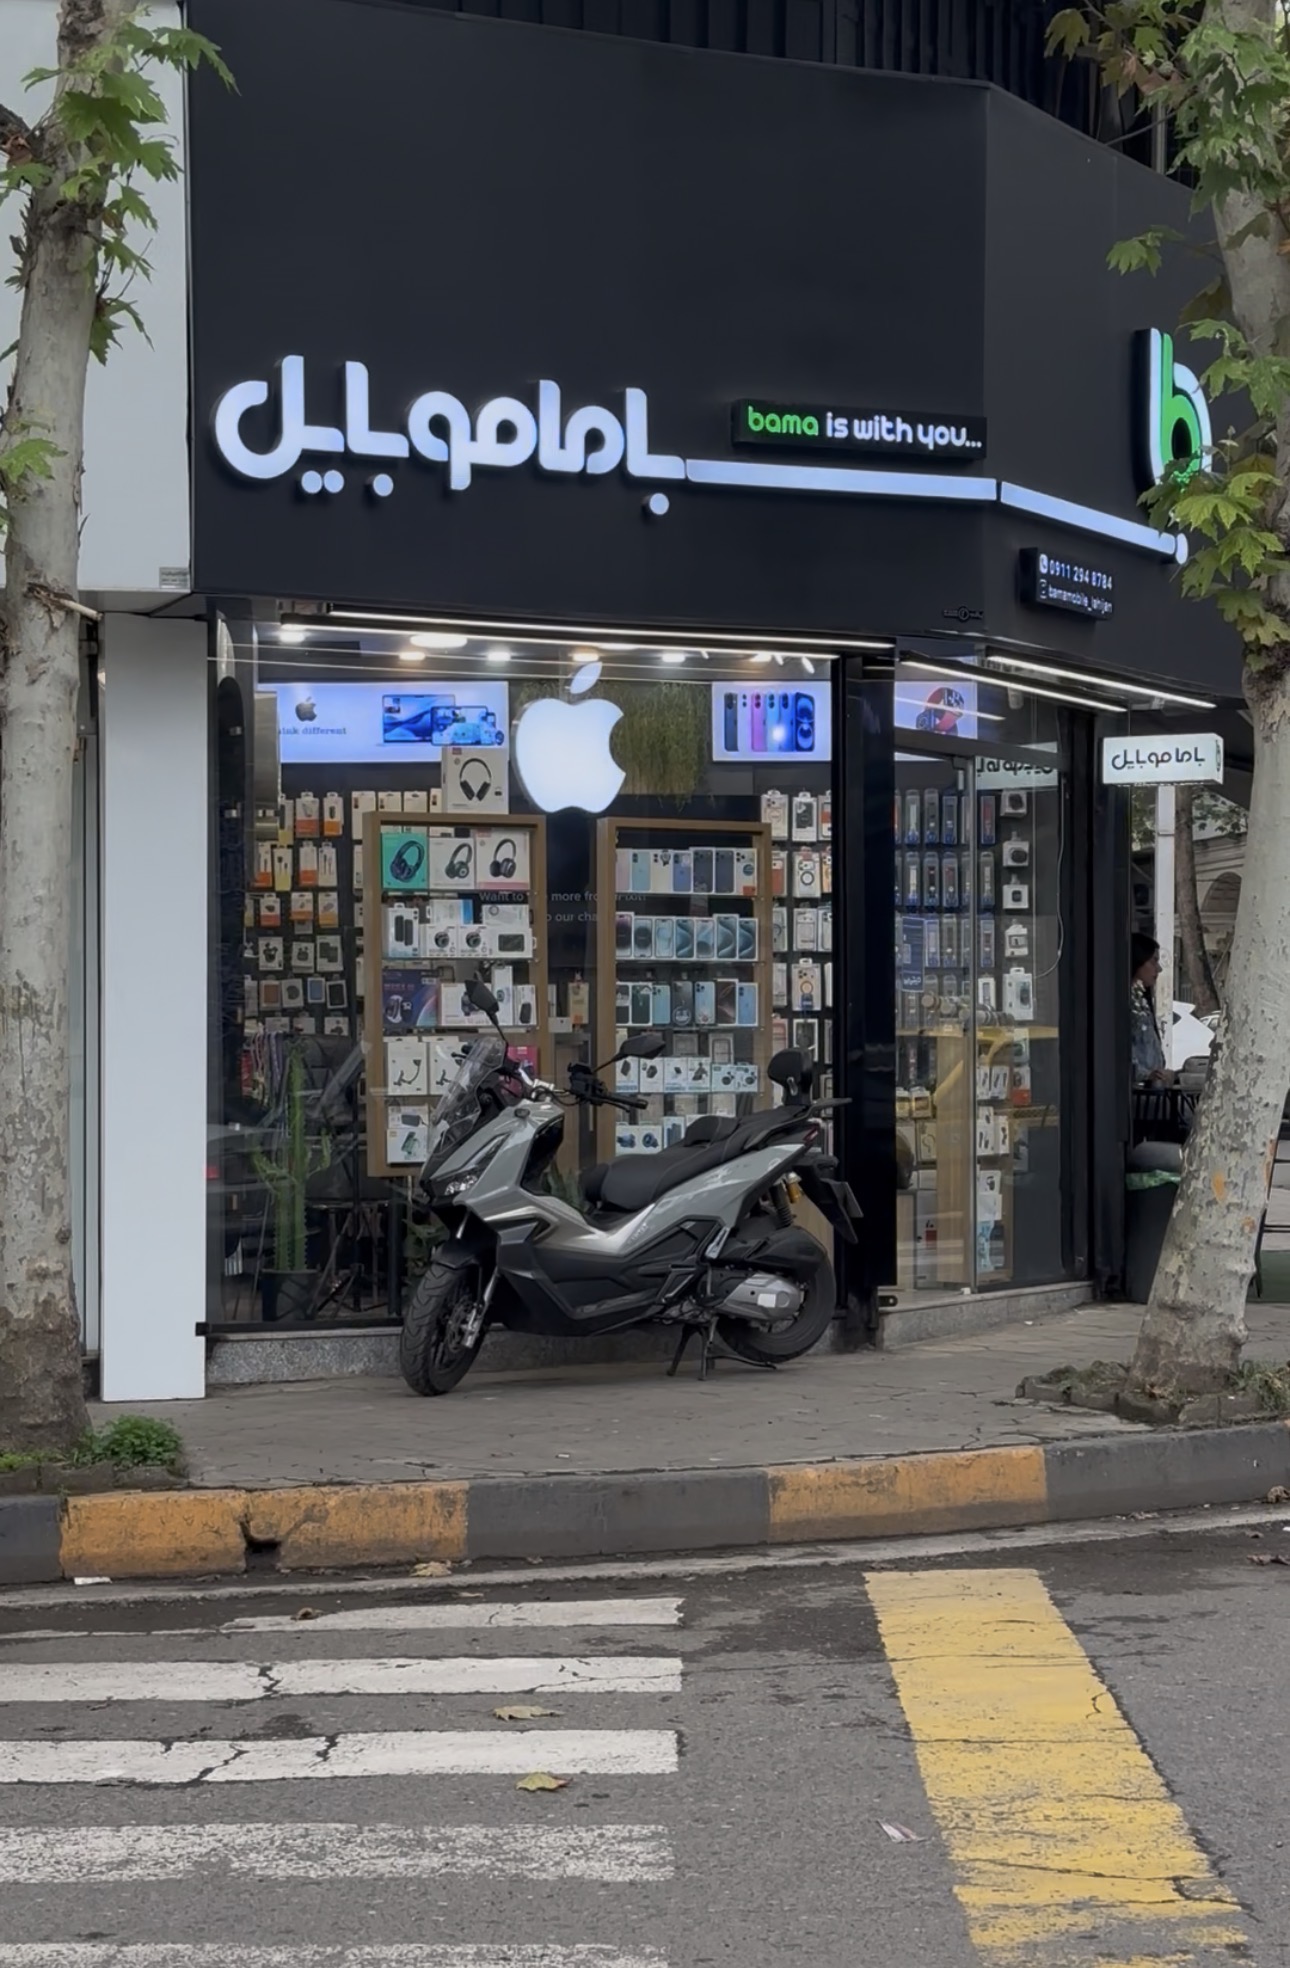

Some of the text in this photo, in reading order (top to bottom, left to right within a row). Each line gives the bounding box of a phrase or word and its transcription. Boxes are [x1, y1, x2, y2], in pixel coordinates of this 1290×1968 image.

[748, 405, 982, 450] bama is with you...
[1049, 559, 1070, 579] 0911
[1073, 565, 1089, 584] 294
[302, 727, 346, 735] different
